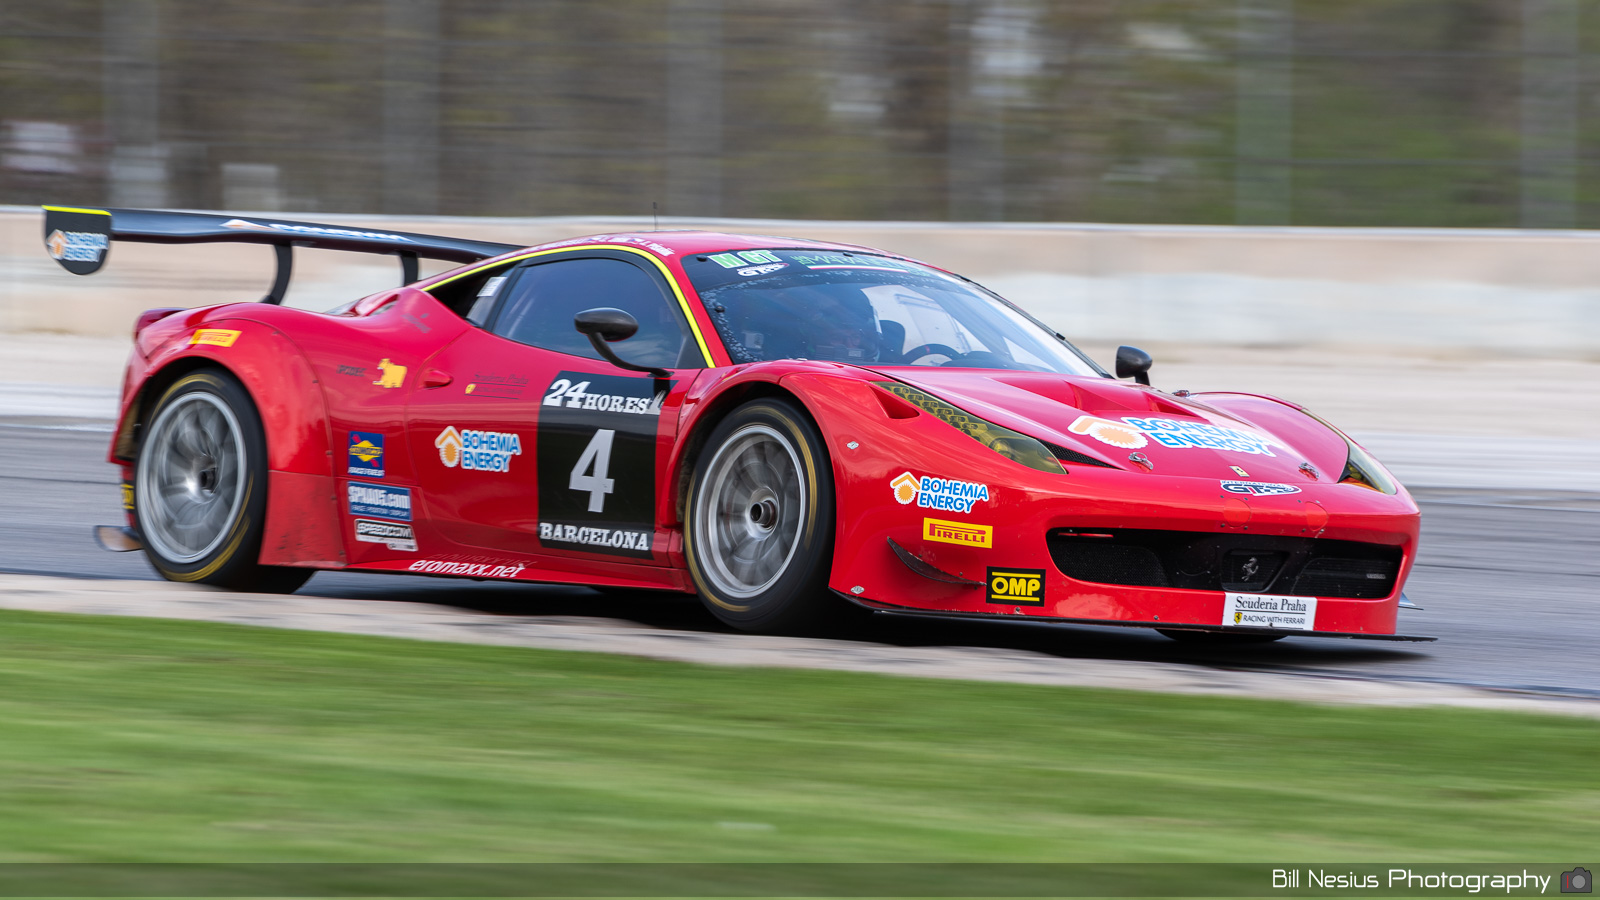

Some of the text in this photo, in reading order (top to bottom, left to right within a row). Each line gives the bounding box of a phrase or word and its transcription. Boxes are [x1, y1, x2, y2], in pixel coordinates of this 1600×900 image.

[462, 430, 520, 454] BOHEMIA
[1127, 418, 1270, 446] BOHEMIA
[1151, 432, 1272, 455] ENERGY
[462, 451, 510, 472] ENERGY
[569, 428, 615, 513] 4
[921, 478, 988, 500] BOHEMIA
[919, 493, 975, 512] ENERGY
[539, 522, 649, 551] BARCELONA
[929, 523, 986, 543] PIRELLI
[408, 559, 526, 578] eromaxx.net
[991, 577, 1041, 597] OMP
[1235, 596, 1307, 611] Scuderia Praha
[1243, 614, 1306, 625] RACING WITH FERRARI
